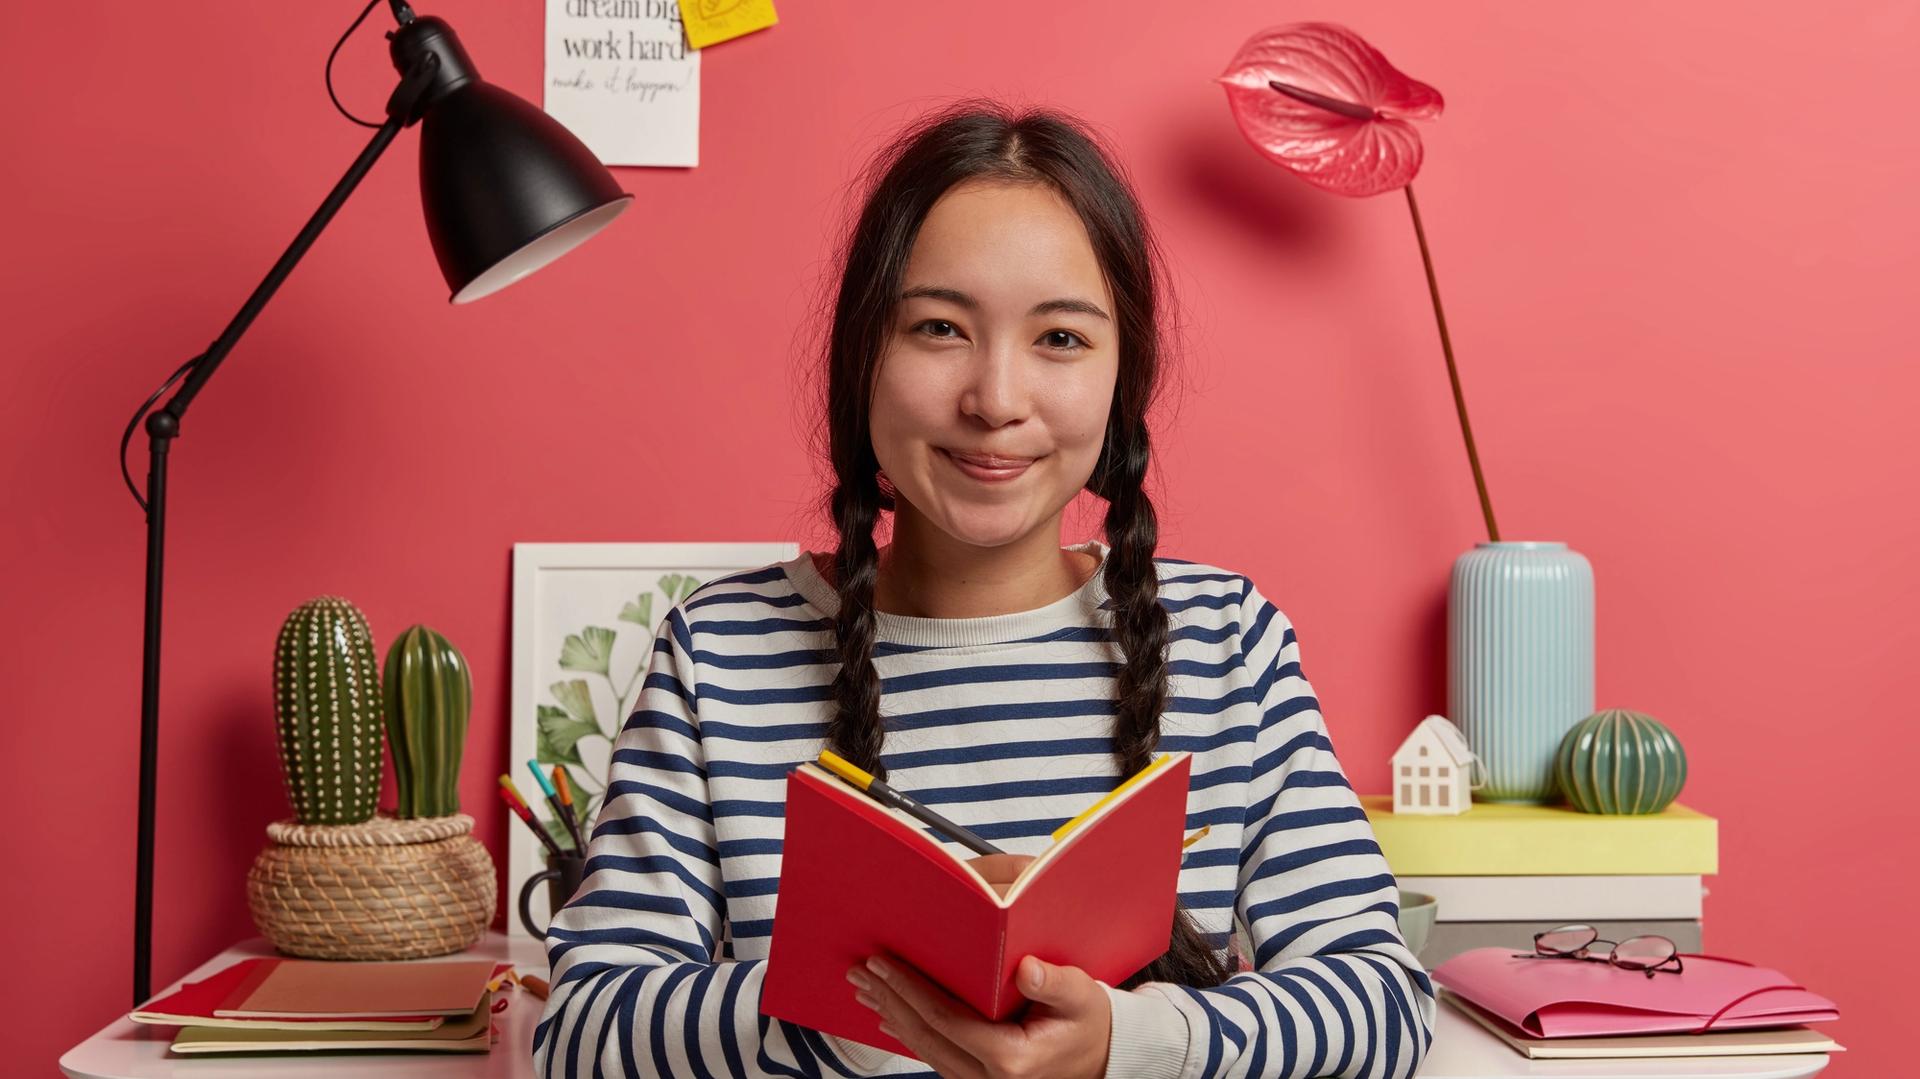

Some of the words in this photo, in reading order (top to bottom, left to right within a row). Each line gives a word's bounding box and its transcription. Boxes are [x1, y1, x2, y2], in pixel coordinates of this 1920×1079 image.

[565, 0, 641, 19] dream
[564, 30, 621, 60] work
[629, 30, 685, 60] hard
[552, 69, 595, 91] make
[604, 66, 621, 94] it
